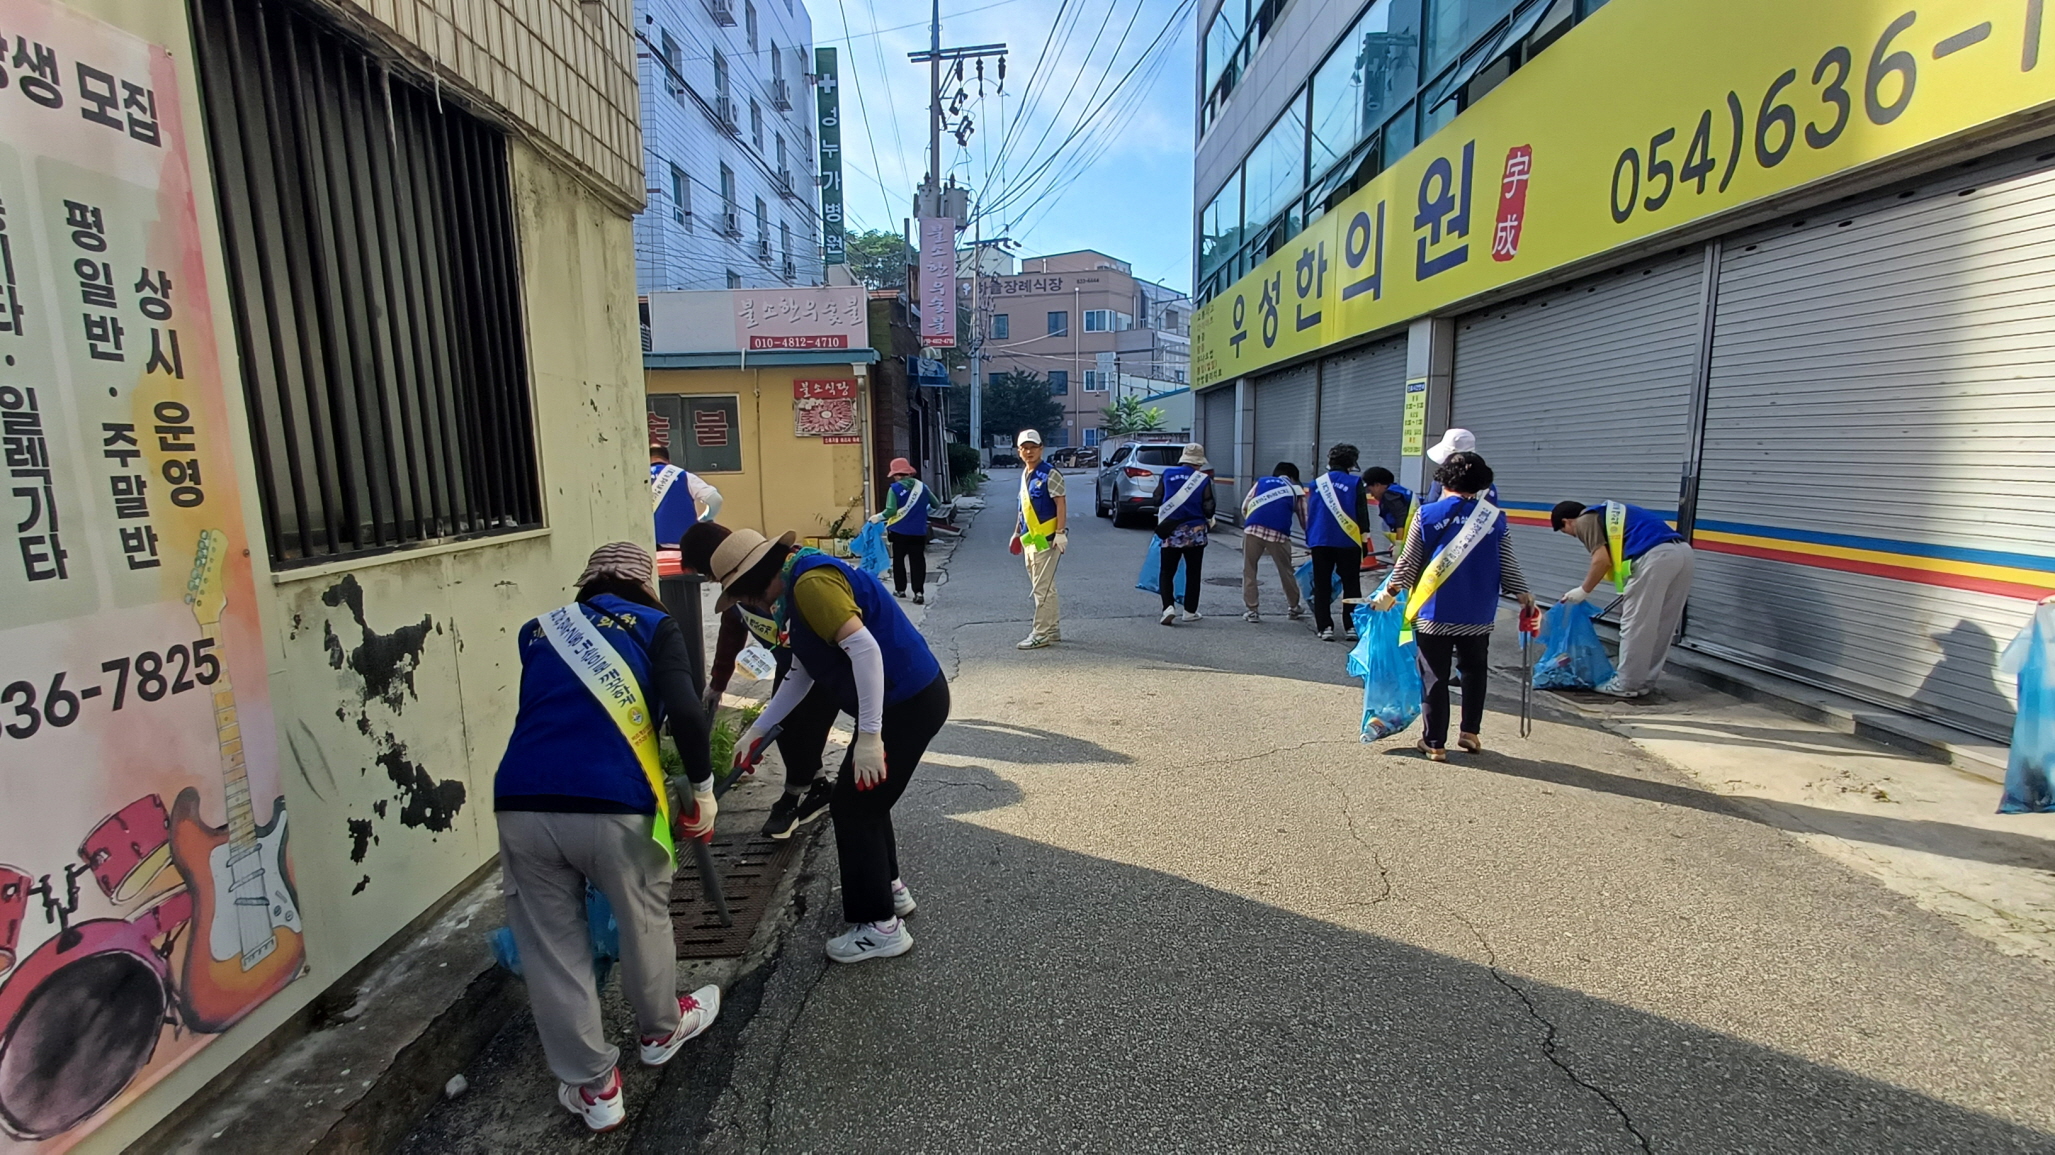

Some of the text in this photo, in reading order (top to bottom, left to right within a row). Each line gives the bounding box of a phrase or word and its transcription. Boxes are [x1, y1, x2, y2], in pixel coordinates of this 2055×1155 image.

[0, 35, 162, 148] 생 모집
[1229, 140, 1476, 358] 우성한의원
[134, 267, 205, 508] 상시 운영
[754, 337, 840, 348] 010-4812-4710
[799, 381, 850, 398] 불소식당
[0, 385, 69, 581] 일렉기타
[0, 637, 220, 739] 36-7825
[599, 668, 637, 708] 깨끗하게
